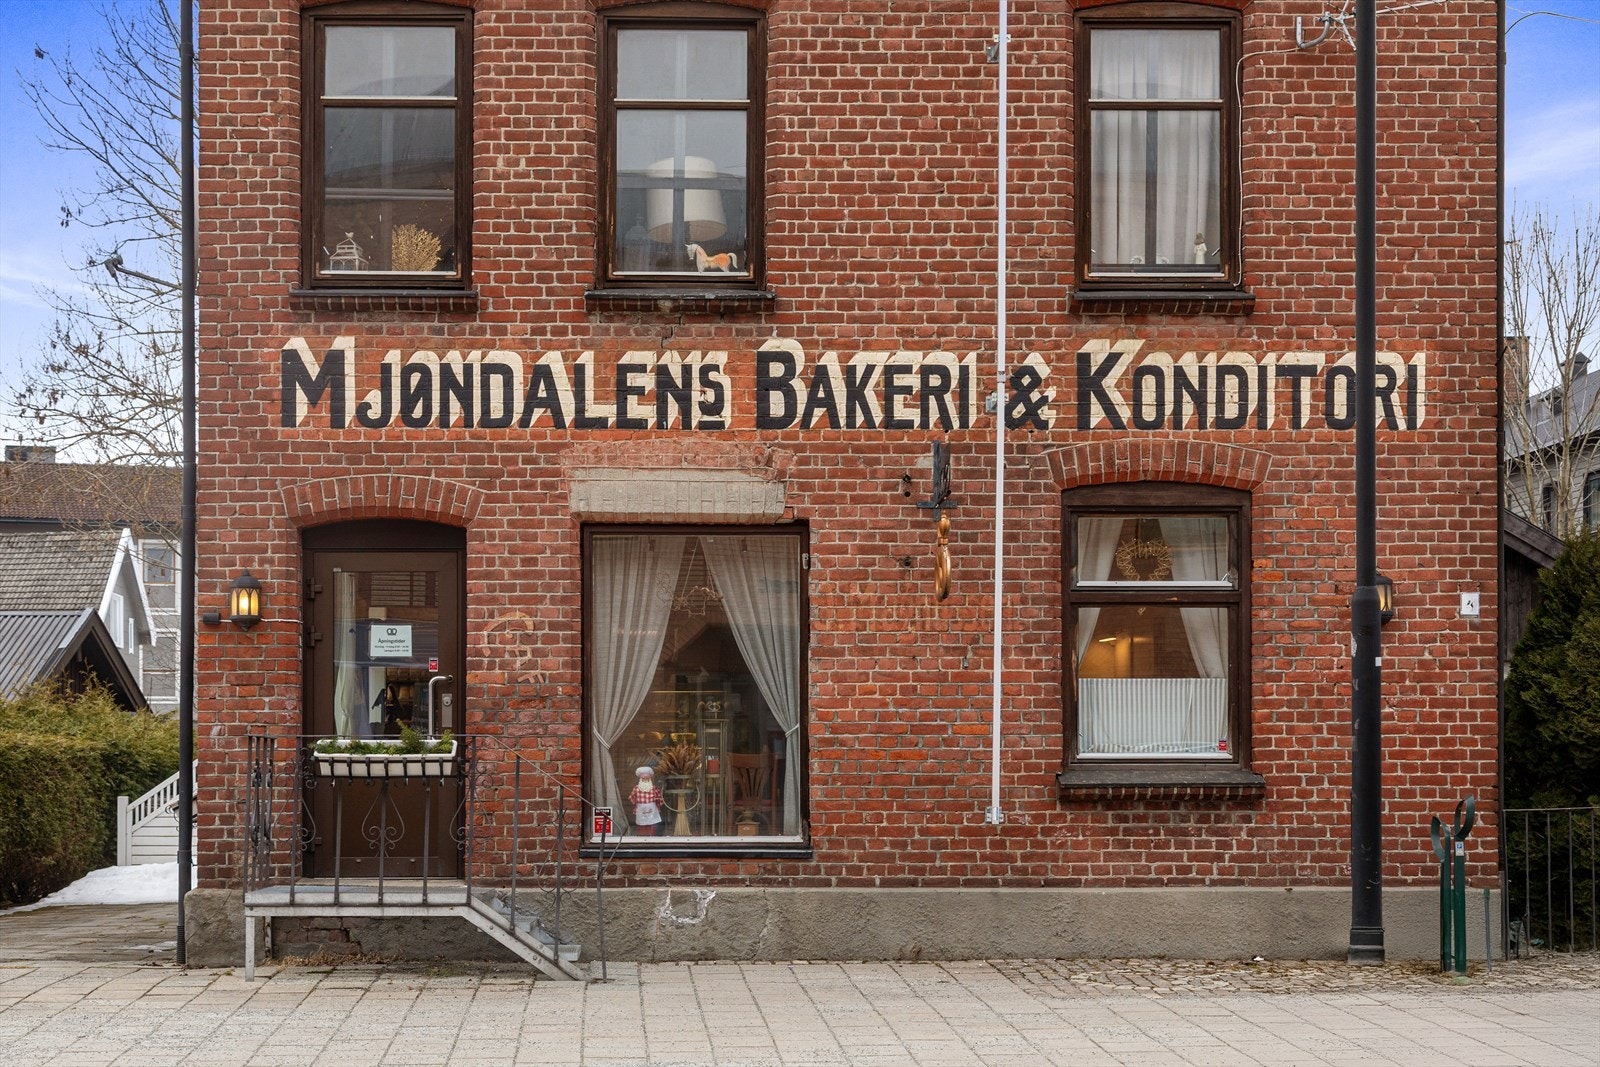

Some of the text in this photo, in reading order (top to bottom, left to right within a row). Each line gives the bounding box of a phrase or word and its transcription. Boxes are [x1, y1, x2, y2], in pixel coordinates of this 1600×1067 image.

[280, 338, 1426, 431] MJØNDALENS BAKERI & KONDITORI
